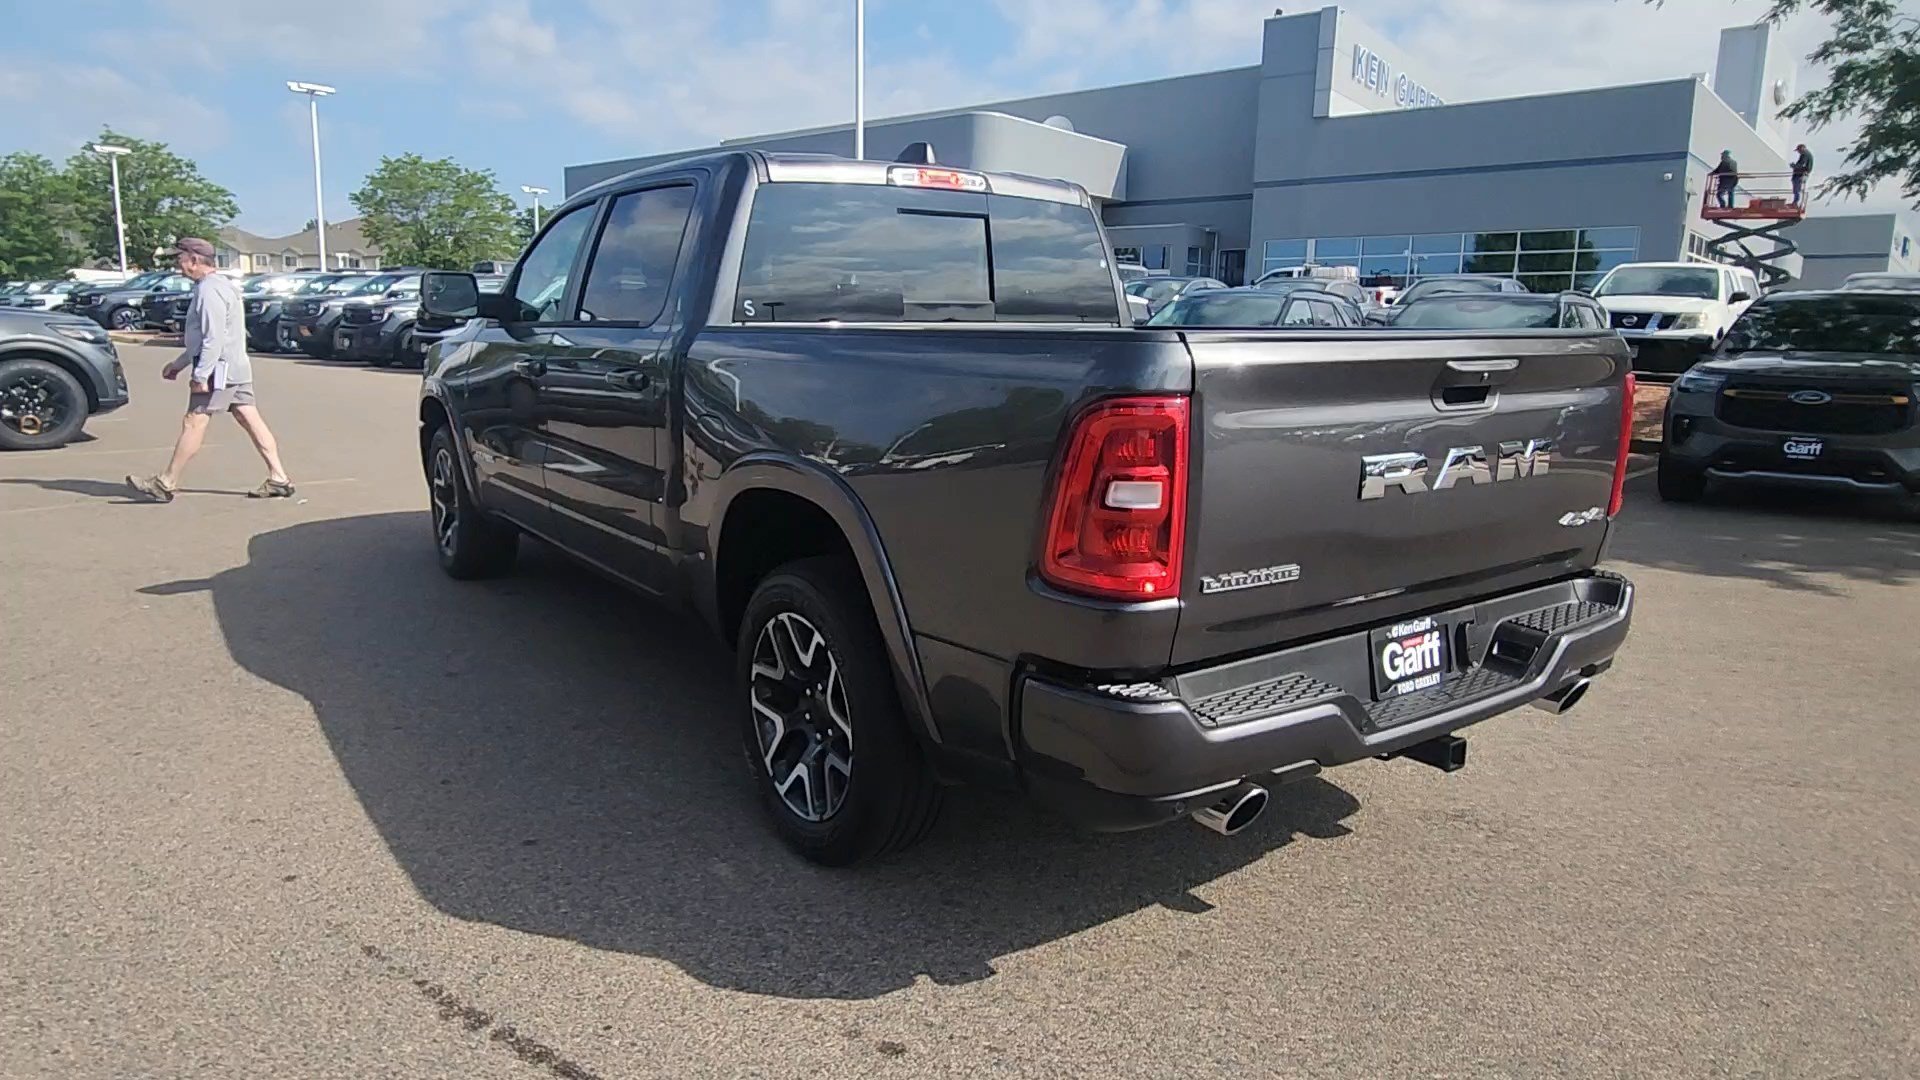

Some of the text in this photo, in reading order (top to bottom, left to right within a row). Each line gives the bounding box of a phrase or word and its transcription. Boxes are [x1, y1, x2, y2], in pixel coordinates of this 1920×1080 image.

[1352, 43, 1444, 108] KEN GAR
[1359, 438, 1551, 500] RAM
[1783, 441, 1823, 455] Garff
[1200, 563, 1300, 593] LARAMIE
[1382, 631, 1441, 681] Garff
